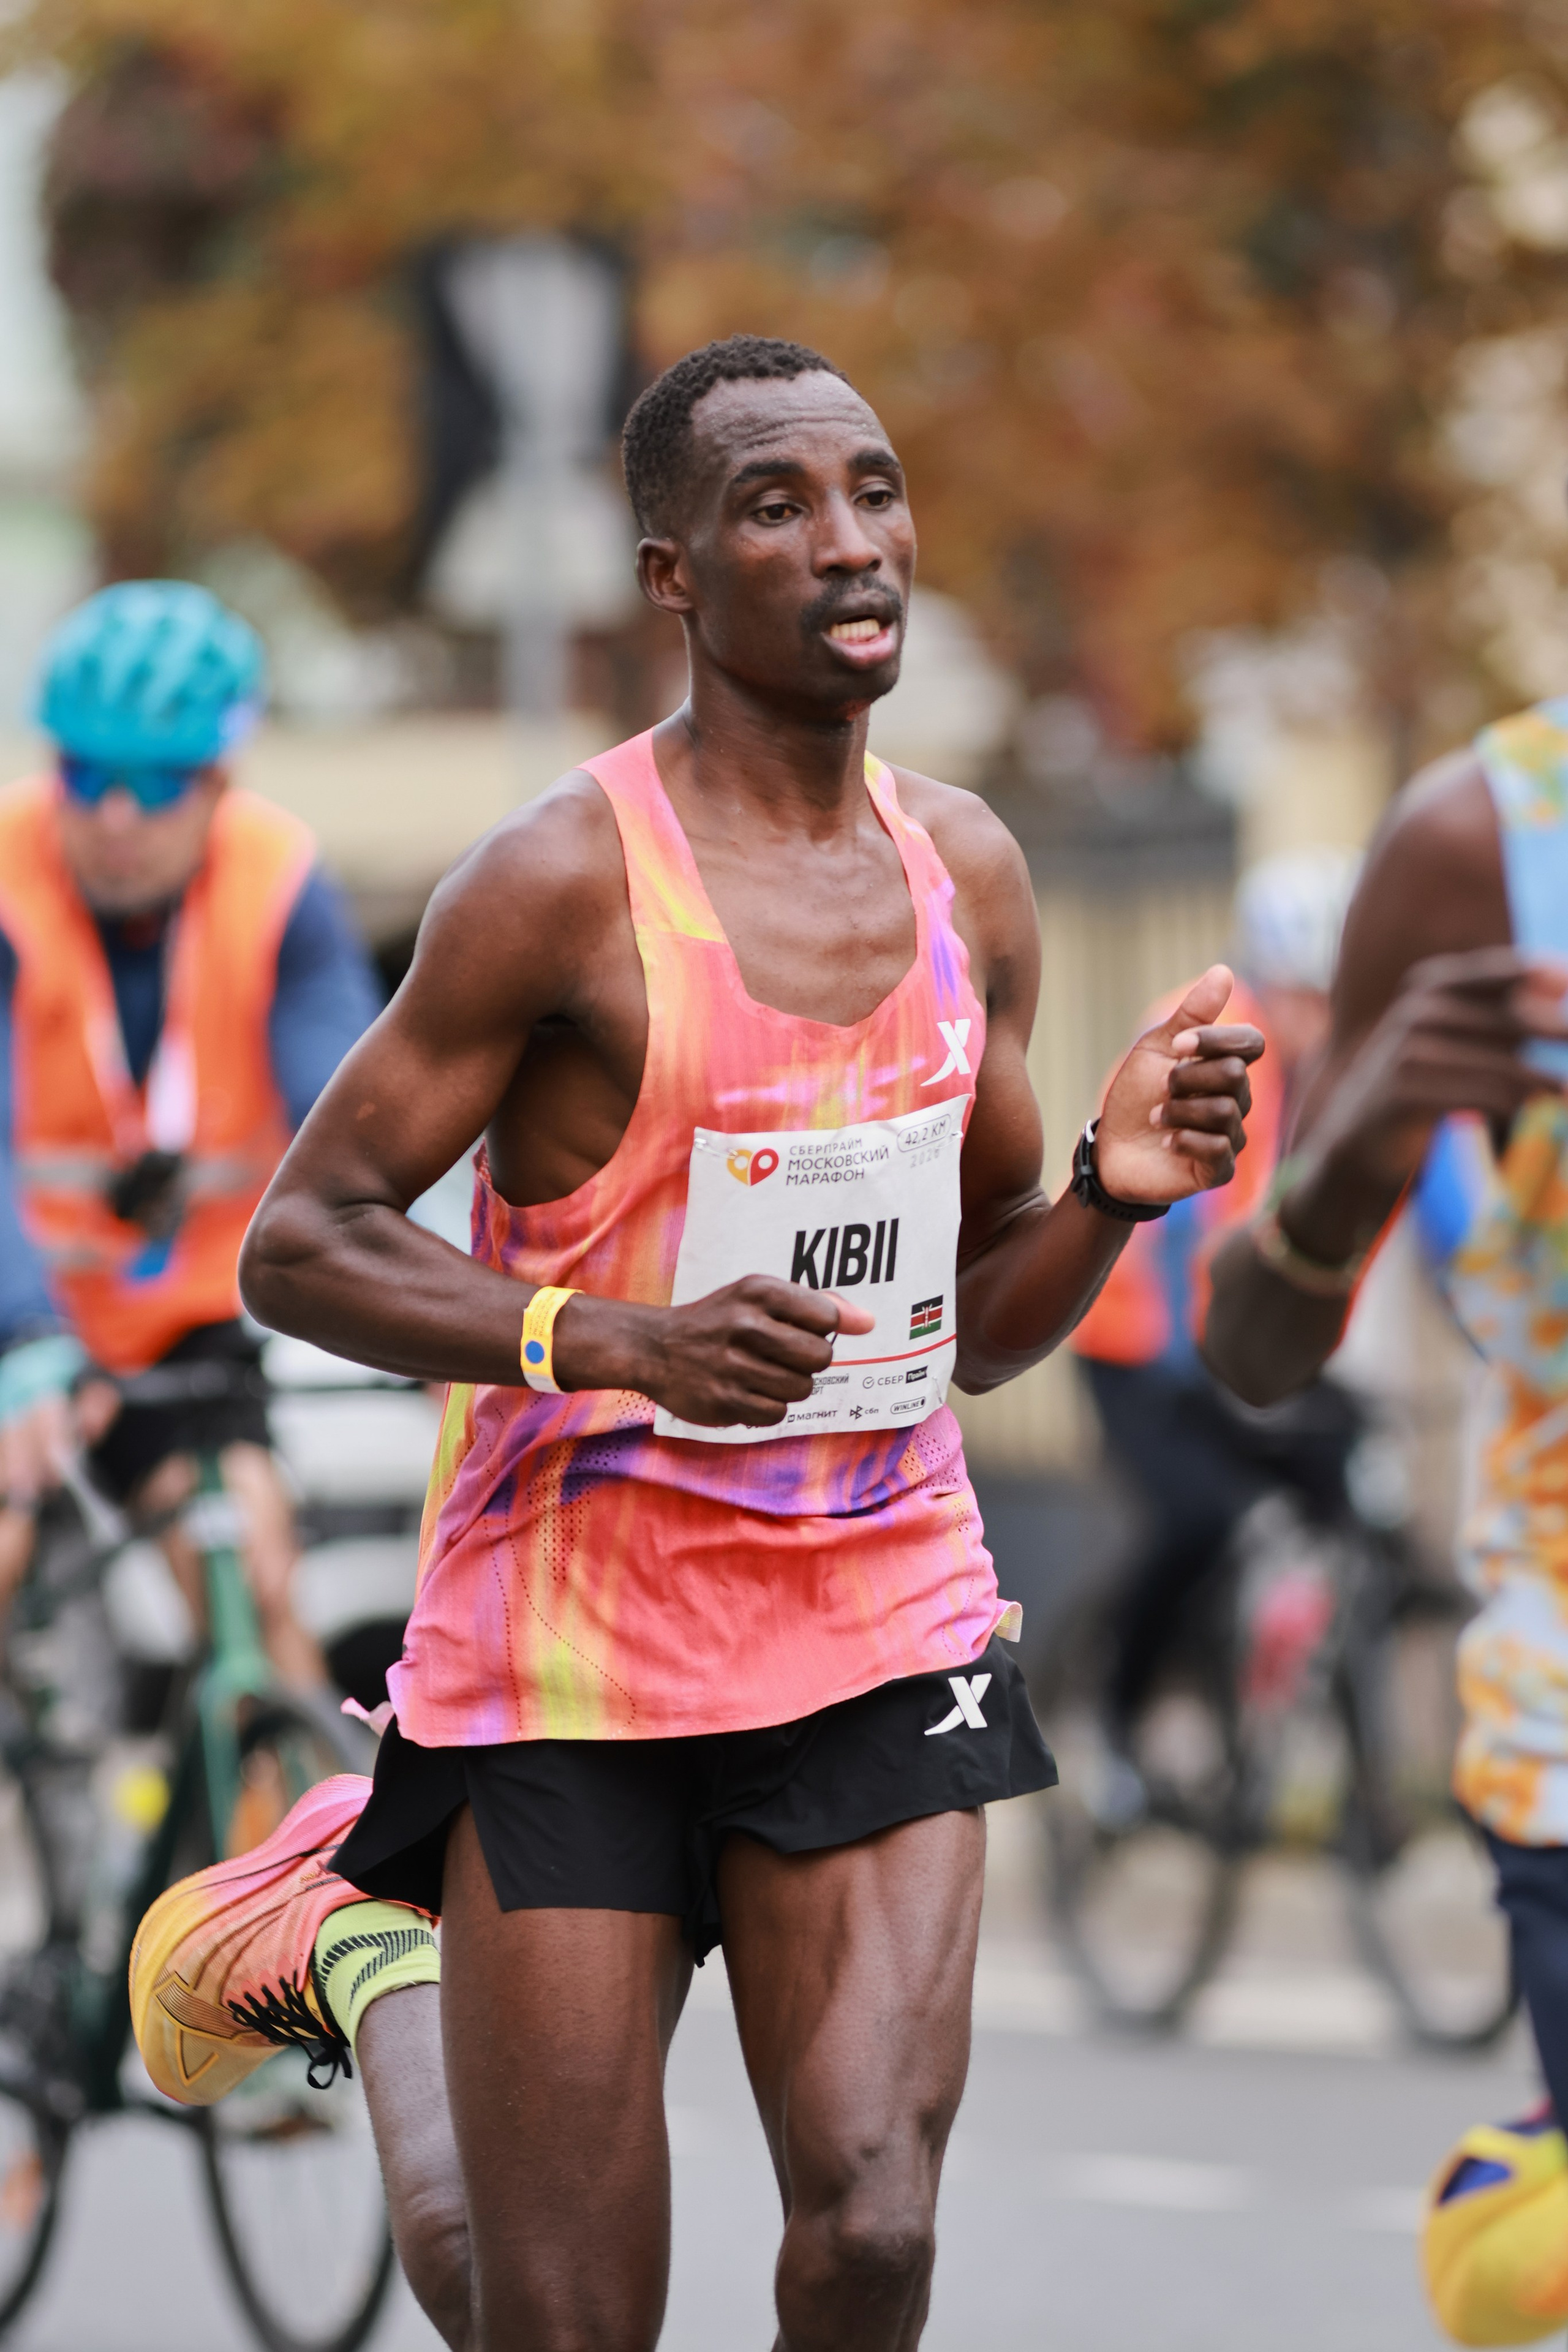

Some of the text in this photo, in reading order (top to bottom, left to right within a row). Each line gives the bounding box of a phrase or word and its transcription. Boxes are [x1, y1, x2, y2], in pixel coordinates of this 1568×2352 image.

[905, 1128, 928, 1145] 42,2
[790, 1138, 862, 1156] СБЕРПРАЙМ
[788, 1147, 889, 1171] МОСКОВСКИЙ
[786, 1167, 864, 1186] МАРАФОН
[791, 1218, 900, 1291] KIBII
[813, 1373, 850, 1385] СКОВСКИЙ
[878, 1375, 903, 1386] СБЕР
[811, 1387, 823, 1395] ОРТ
[894, 1400, 920, 1412] WINLINE
[796, 1410, 838, 1421] магнит
